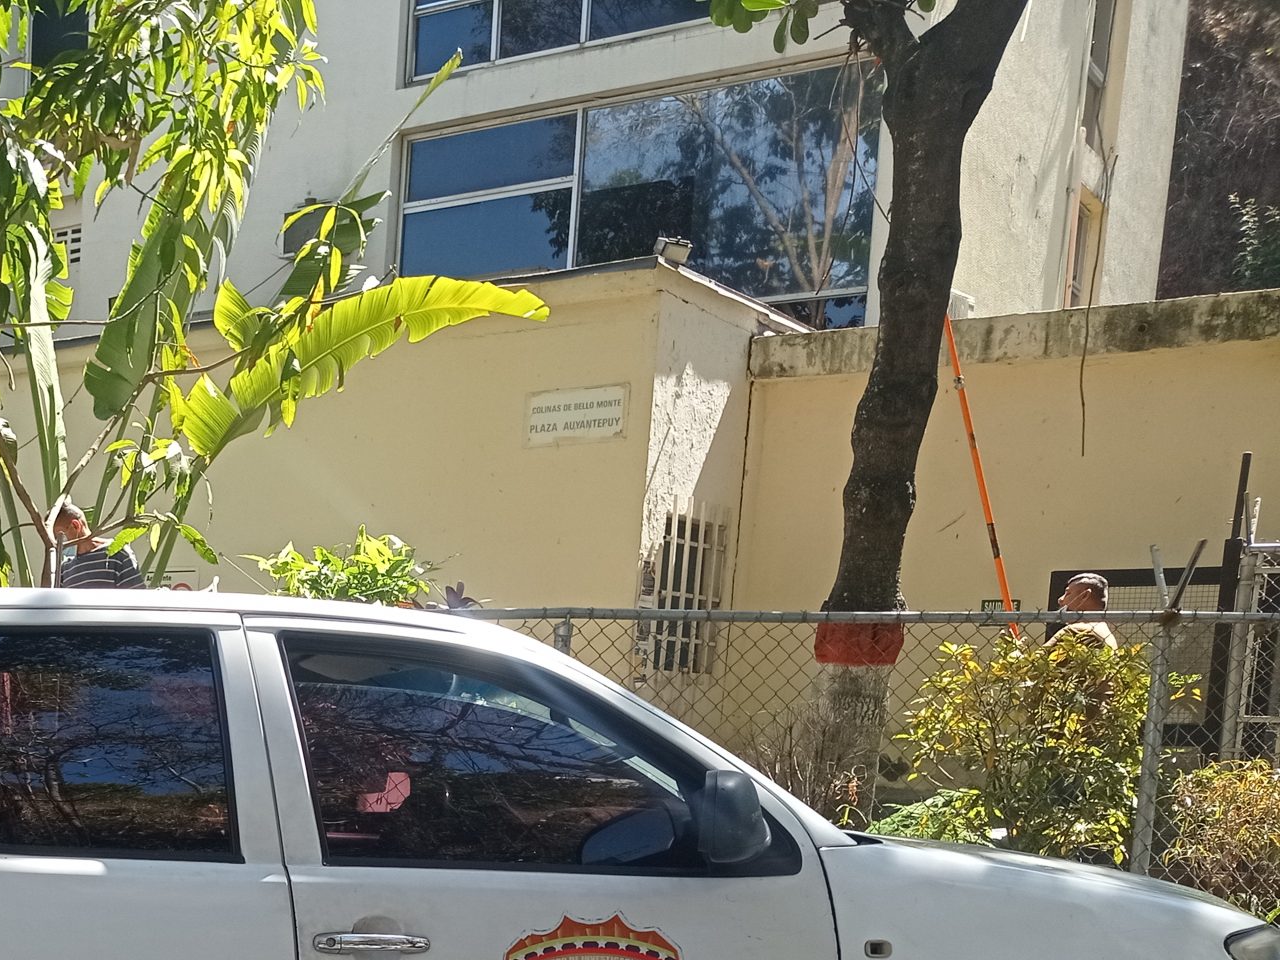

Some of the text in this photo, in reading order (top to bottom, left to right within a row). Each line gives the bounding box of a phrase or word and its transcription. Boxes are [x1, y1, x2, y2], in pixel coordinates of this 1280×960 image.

[532, 399, 622, 414] COLINAS DE BELLO MONTE
[529, 417, 621, 433] PLAZA AUYANTEPUY
